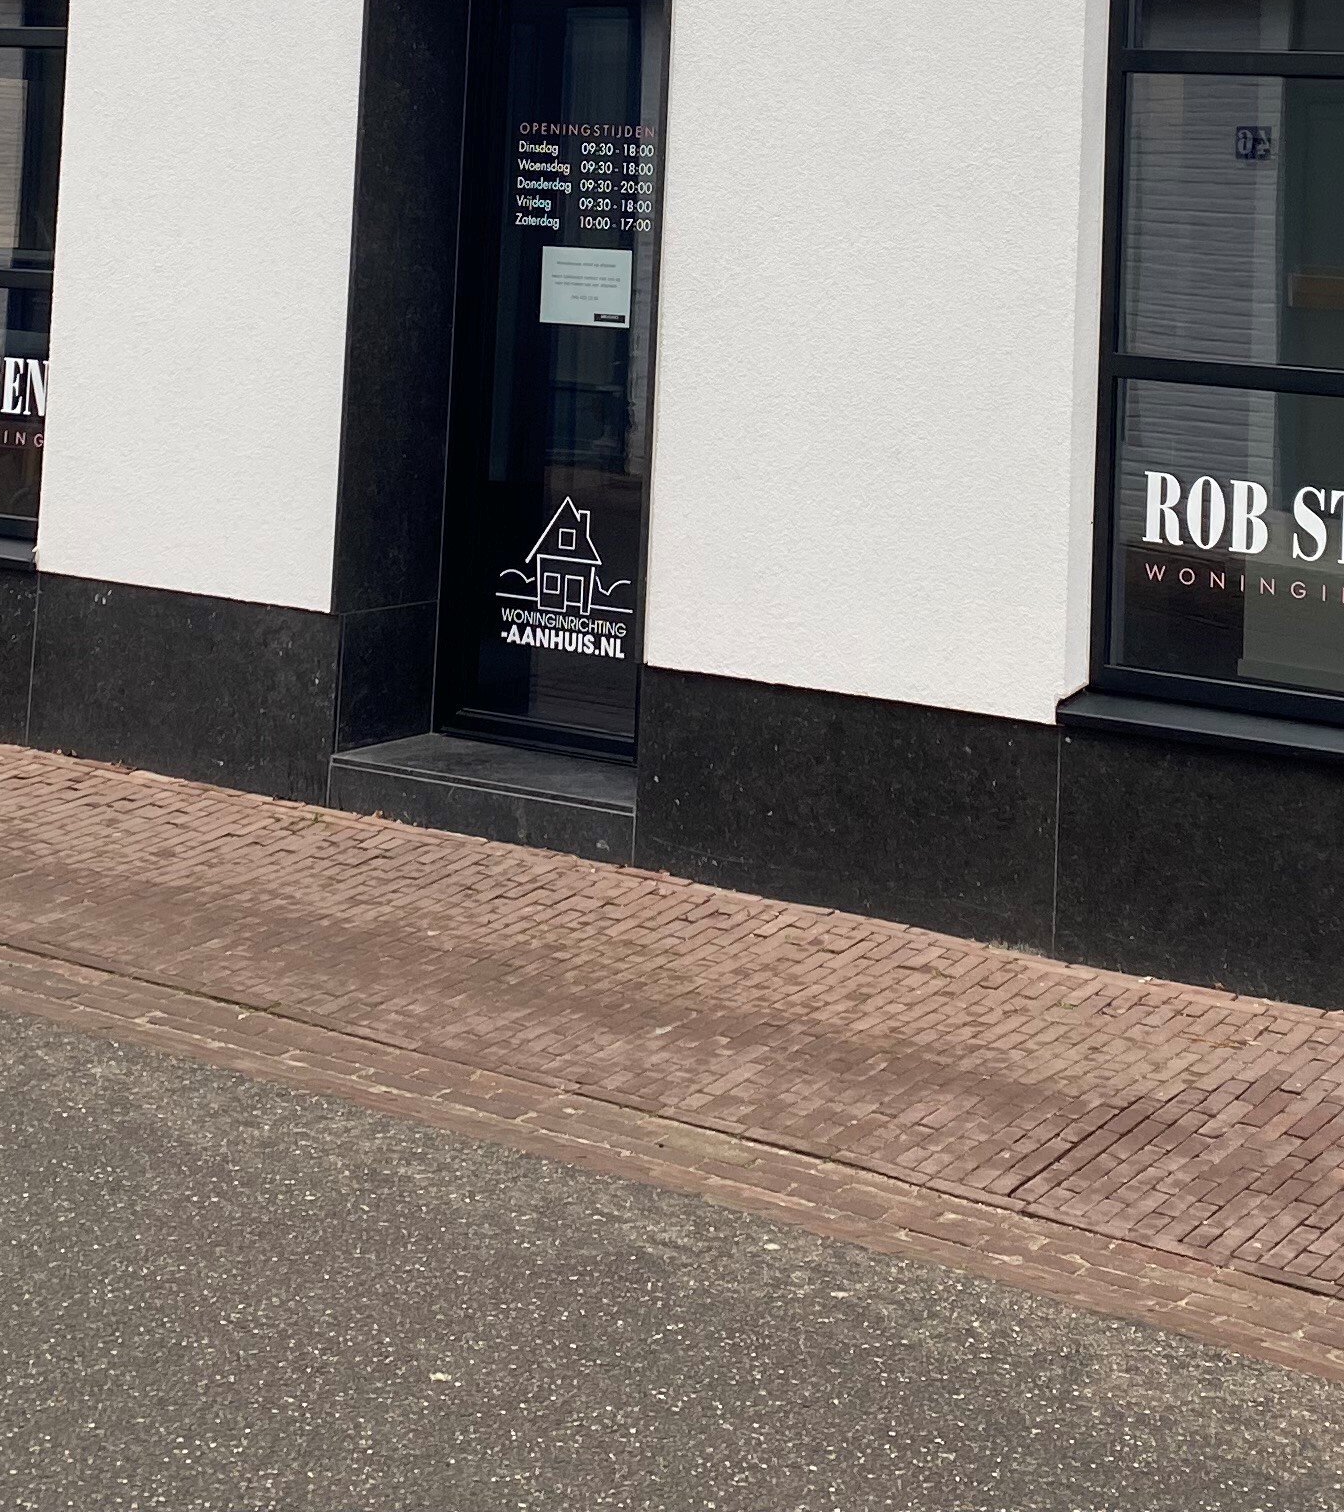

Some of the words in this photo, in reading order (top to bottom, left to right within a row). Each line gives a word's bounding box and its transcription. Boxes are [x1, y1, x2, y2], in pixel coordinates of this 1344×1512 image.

[519, 122, 655, 138] OPENINGSTIJDEN
[518, 141, 559, 157] Dinsdag
[581, 142, 614, 156] 09:30
[623, 144, 654, 157] 18:00
[518, 159, 571, 174] Woensdag
[580, 161, 613, 174] 09:30
[622, 162, 654, 175] 18:00
[517, 177, 572, 194] Donderdag
[579, 179, 612, 193] 09:30
[620, 182, 653, 195] 20:00
[515, 195, 552, 211] Vrijdag
[579, 198, 611, 211] 09:30
[621, 200, 652, 213] 18:00
[515, 213, 560, 230] Zaterdag
[579, 216, 610, 229] 10:00
[620, 218, 651, 232] 17:00
[1141, 470, 1269, 555] ROB
[501, 607, 627, 637] WONINGINRICHTING
[501, 624, 625, 659] -AANHUIS.NL
